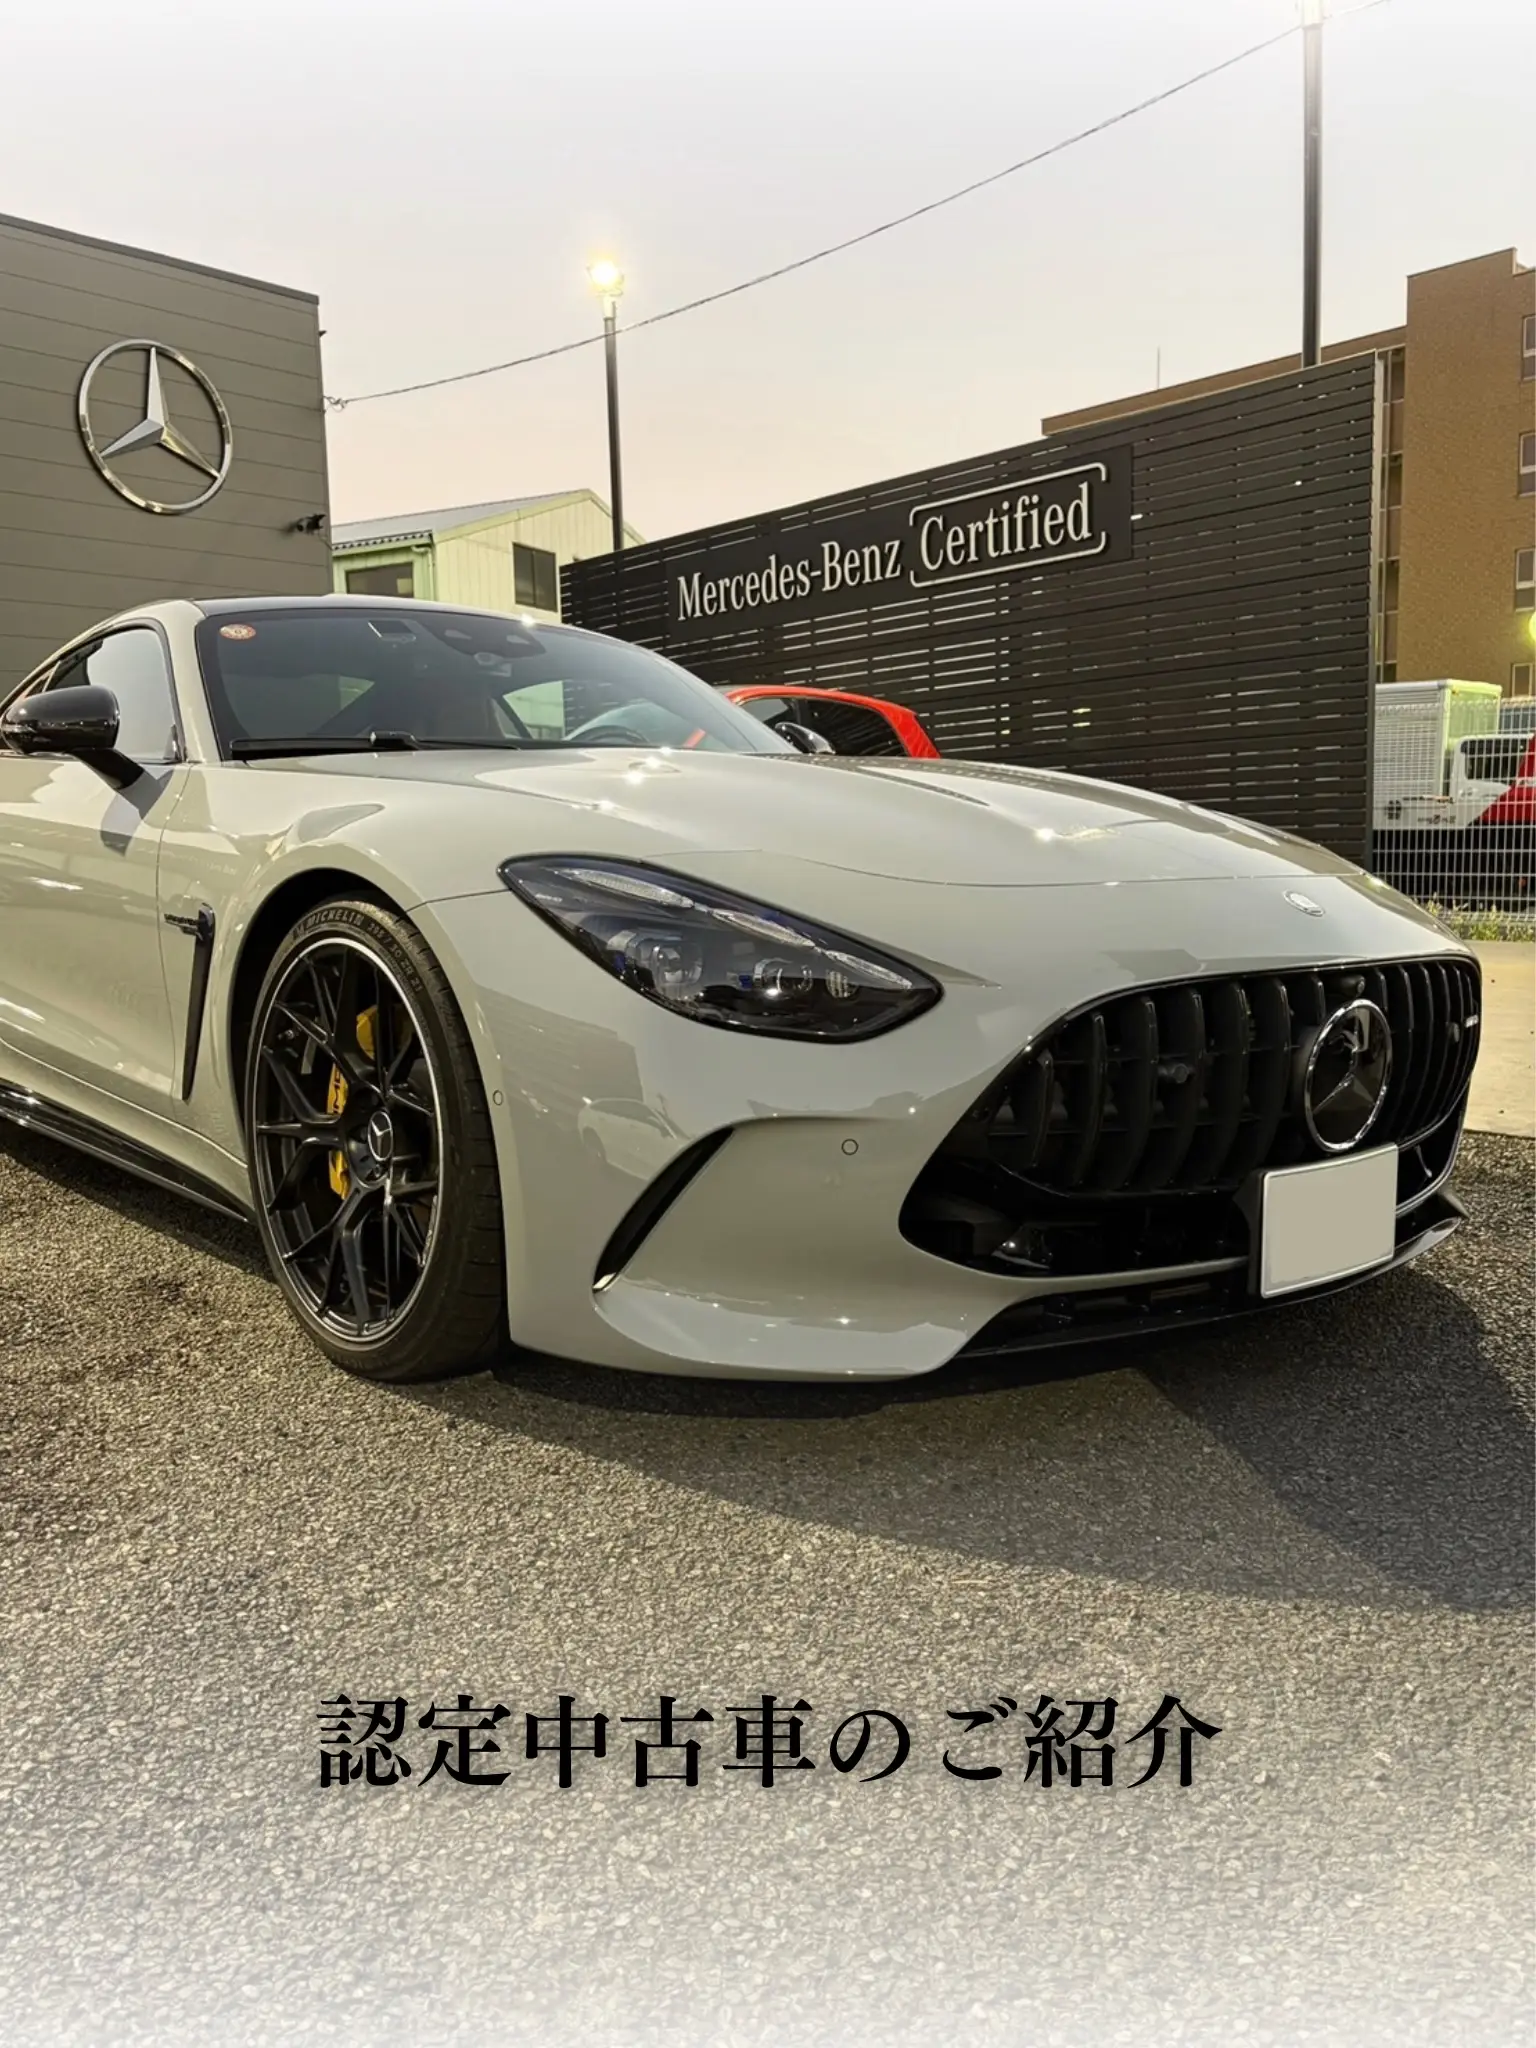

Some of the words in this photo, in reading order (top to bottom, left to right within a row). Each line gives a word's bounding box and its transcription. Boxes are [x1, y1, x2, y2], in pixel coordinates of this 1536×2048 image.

[677, 539, 902, 621] Mercedes-Benz
[920, 482, 1092, 571] Certified
[306, 908, 365, 929] MICHELIN
